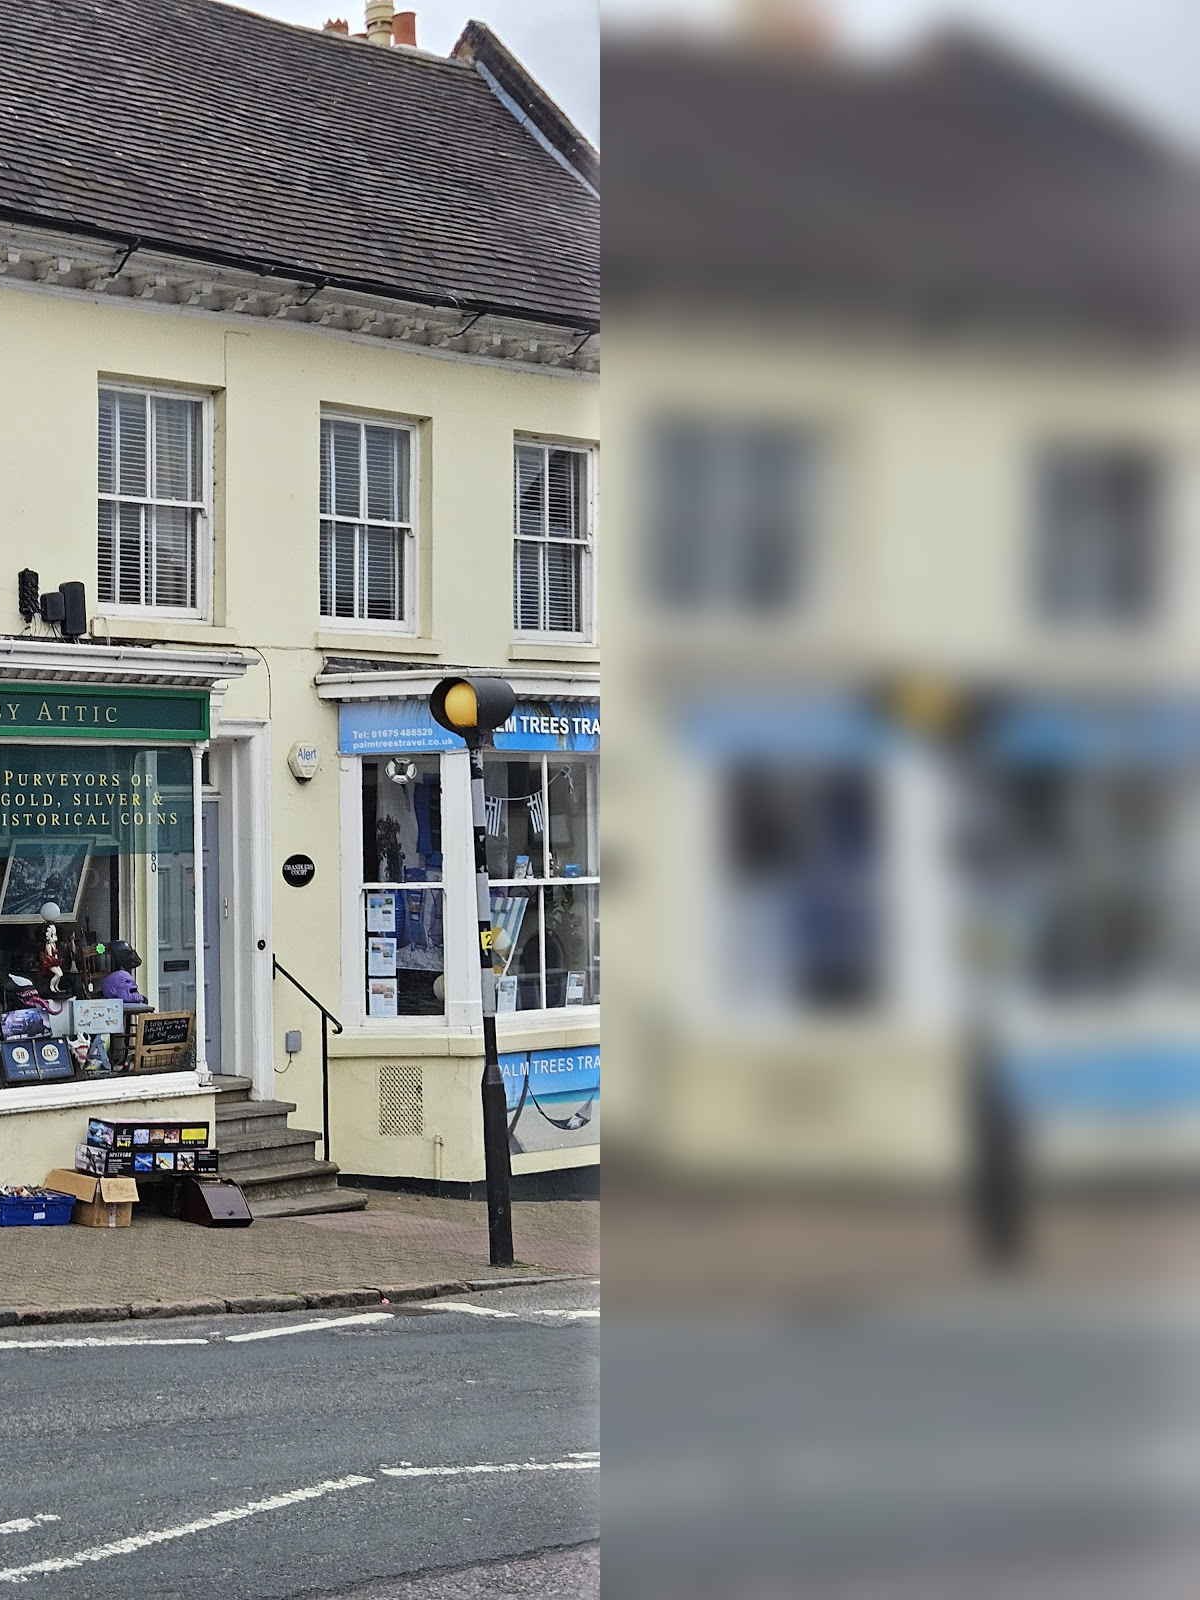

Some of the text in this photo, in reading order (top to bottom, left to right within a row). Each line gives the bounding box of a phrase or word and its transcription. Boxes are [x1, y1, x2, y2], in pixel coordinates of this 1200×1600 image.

[37, 701, 118, 723] ATTIC
[520, 715, 570, 734] TREES
[352, 728, 433, 739] Tel: 01675 488529
[353, 737, 453, 750] palmtreestravel.co.uk
[297, 748, 316, 760] Alert
[4, 770, 153, 787] PURVEYORS OF
[1, 791, 163, 808] GOLD, SILVER &
[120, 812, 178, 826] COINS
[533, 1057, 573, 1074] TREES
